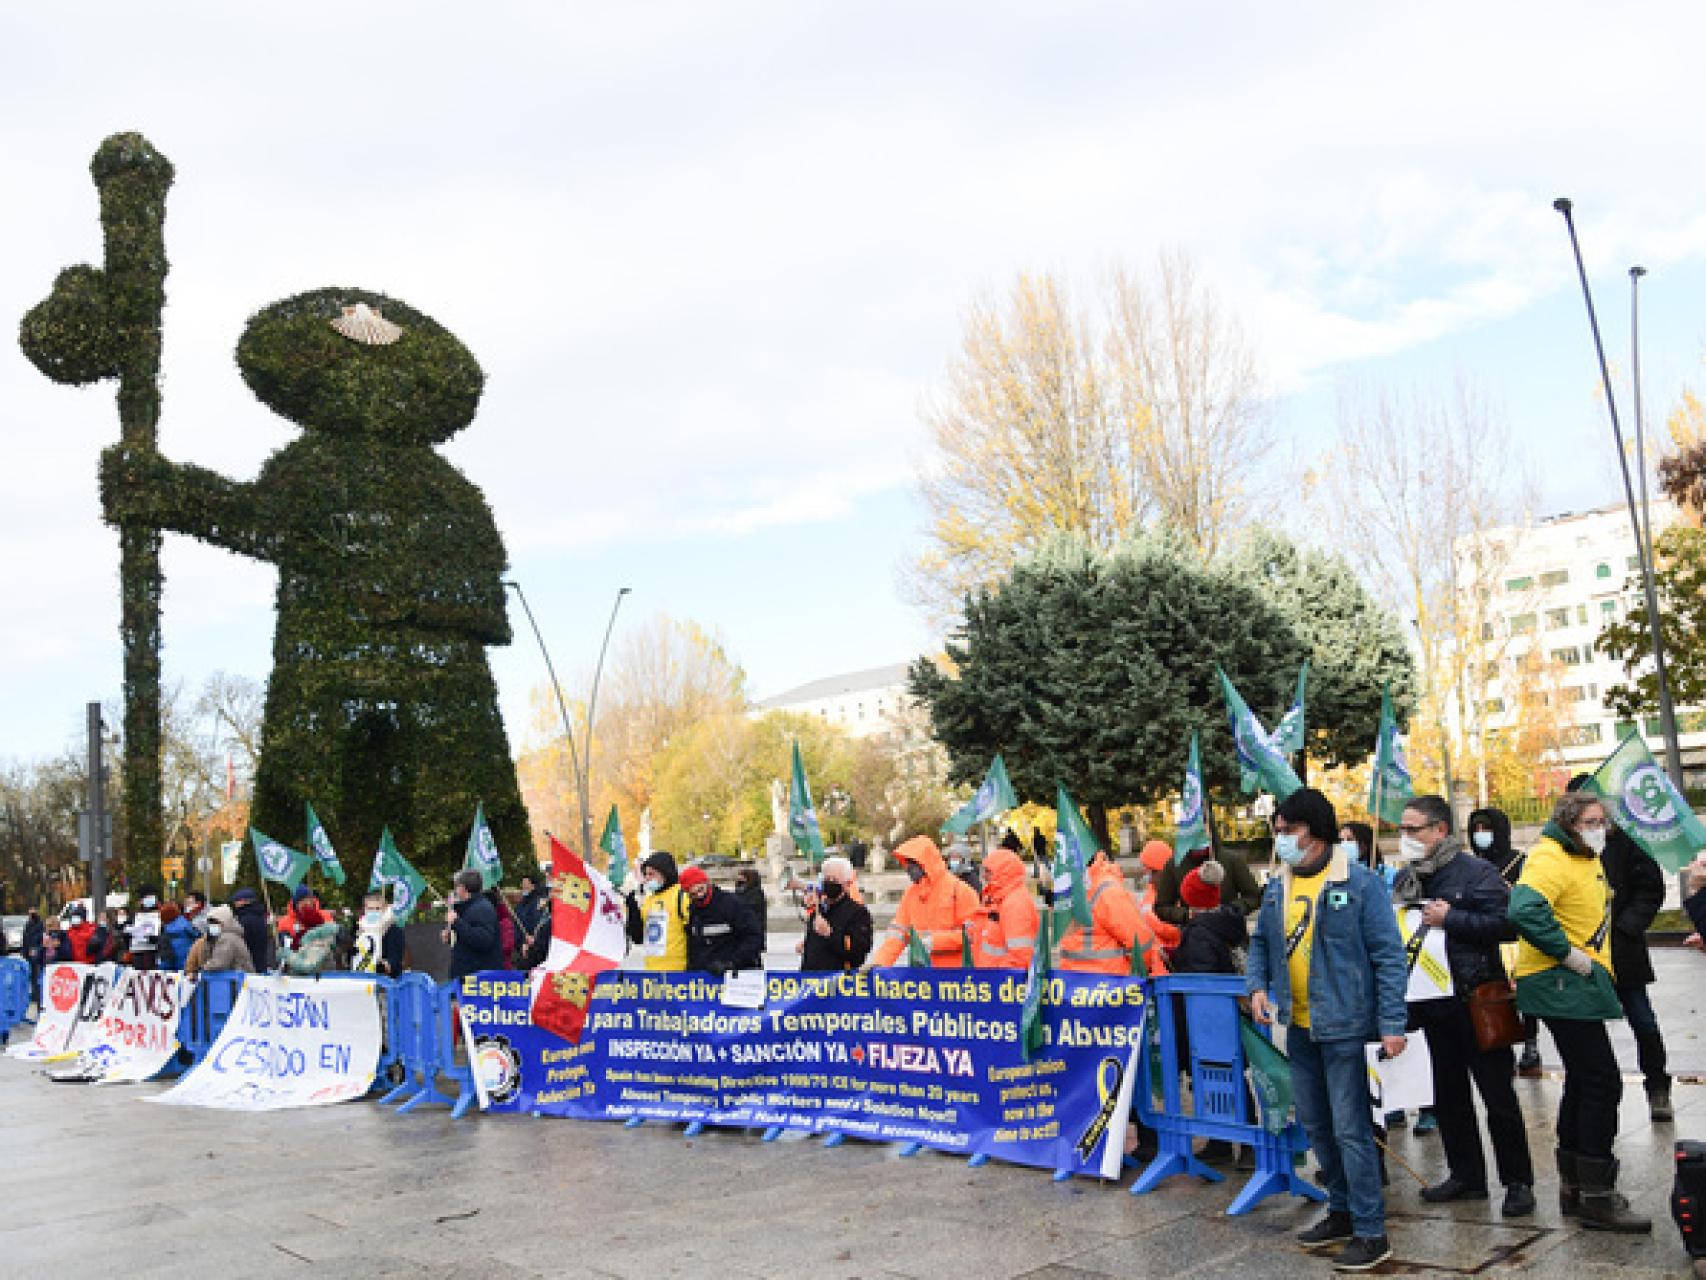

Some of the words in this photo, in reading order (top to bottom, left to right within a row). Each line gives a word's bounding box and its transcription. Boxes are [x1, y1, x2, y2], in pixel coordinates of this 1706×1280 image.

[876, 976, 932, 999] hace
[939, 976, 992, 1002] más
[1000, 976, 1027, 1003] de
[1071, 982, 1144, 1007] años
[593, 1012, 633, 1033] para
[638, 1009, 762, 1036] Trabajadores
[769, 1009, 908, 1035] Temporales
[912, 1009, 1018, 1041] Públicos
[320, 1044, 351, 1074] EN
[608, 1038, 692, 1061] INSPECCIÓN
[694, 1043, 716, 1063] YA
[731, 1038, 821, 1064] SANCIÓN
[824, 1041, 848, 1063] YA
[868, 1042, 942, 1074] FIJEZA
[942, 1048, 975, 1077] YA
